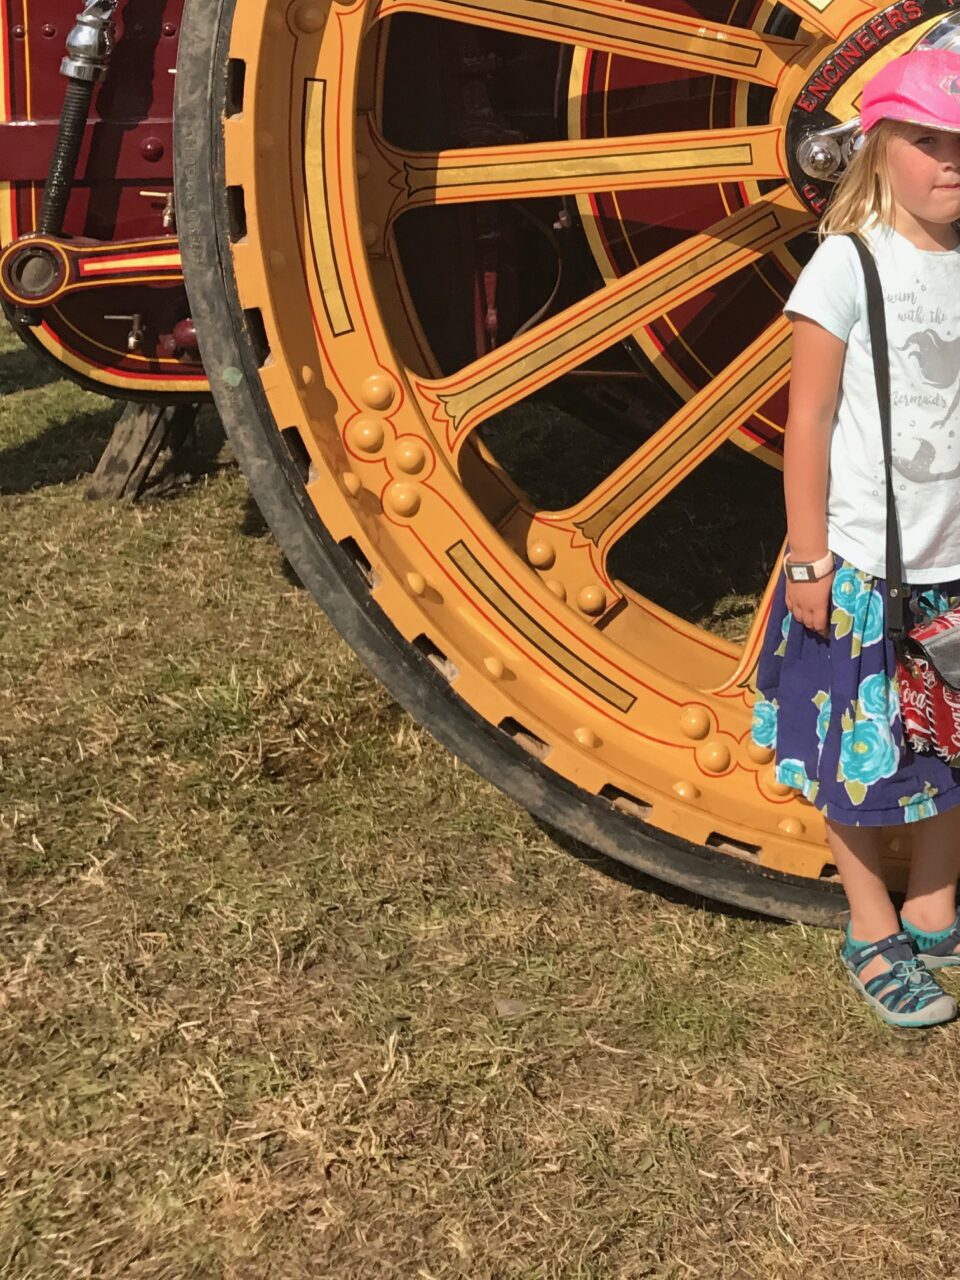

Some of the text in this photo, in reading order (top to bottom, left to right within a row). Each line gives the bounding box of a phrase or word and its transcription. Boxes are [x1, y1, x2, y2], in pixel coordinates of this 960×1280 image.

[796, 0, 923, 113] ENGINEERS
[801, 183, 828, 213] TD
[897, 305, 947, 325] with the
